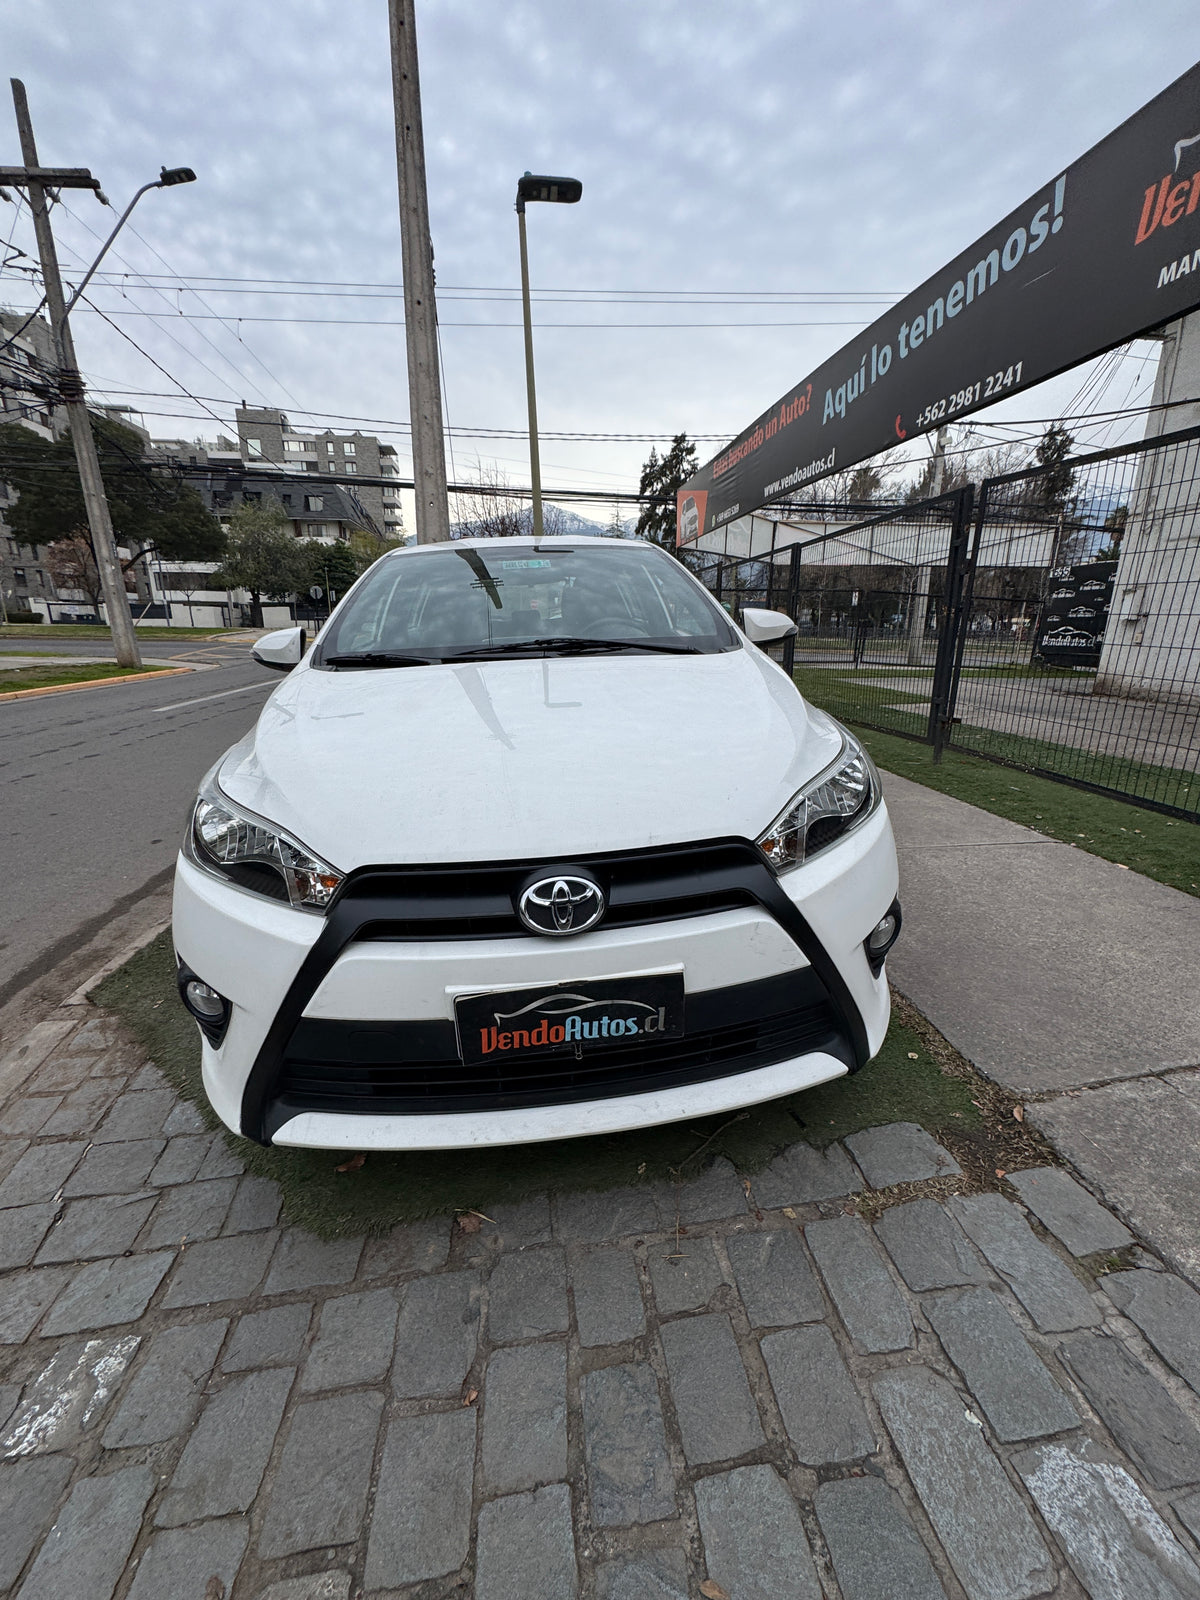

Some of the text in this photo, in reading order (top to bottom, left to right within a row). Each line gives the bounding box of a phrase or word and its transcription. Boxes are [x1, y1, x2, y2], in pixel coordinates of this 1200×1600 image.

[822, 173, 1067, 425] Aquí lo tenemos!
[765, 416, 778, 440] un
[779, 384, 812, 431] Auto?
[916, 361, 1023, 428] +562 2981 2241
[764, 447, 835, 497] www.vendoautos.cl
[480, 1006, 666, 1054] VendoAutos.cl
